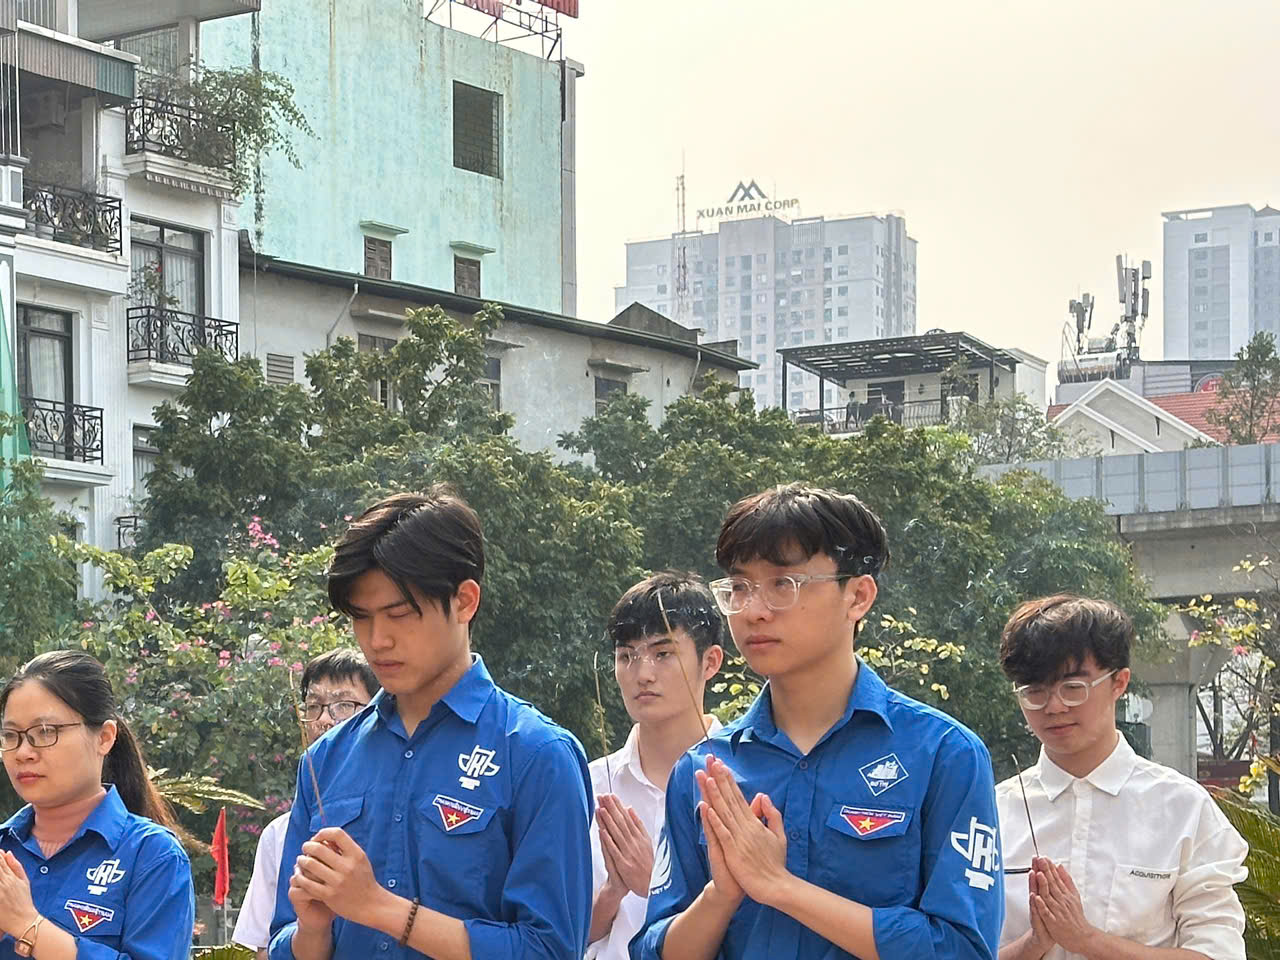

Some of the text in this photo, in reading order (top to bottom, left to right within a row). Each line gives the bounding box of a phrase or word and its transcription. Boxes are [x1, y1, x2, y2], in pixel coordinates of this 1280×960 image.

[697, 198, 799, 219] XUAN MAI CORP
